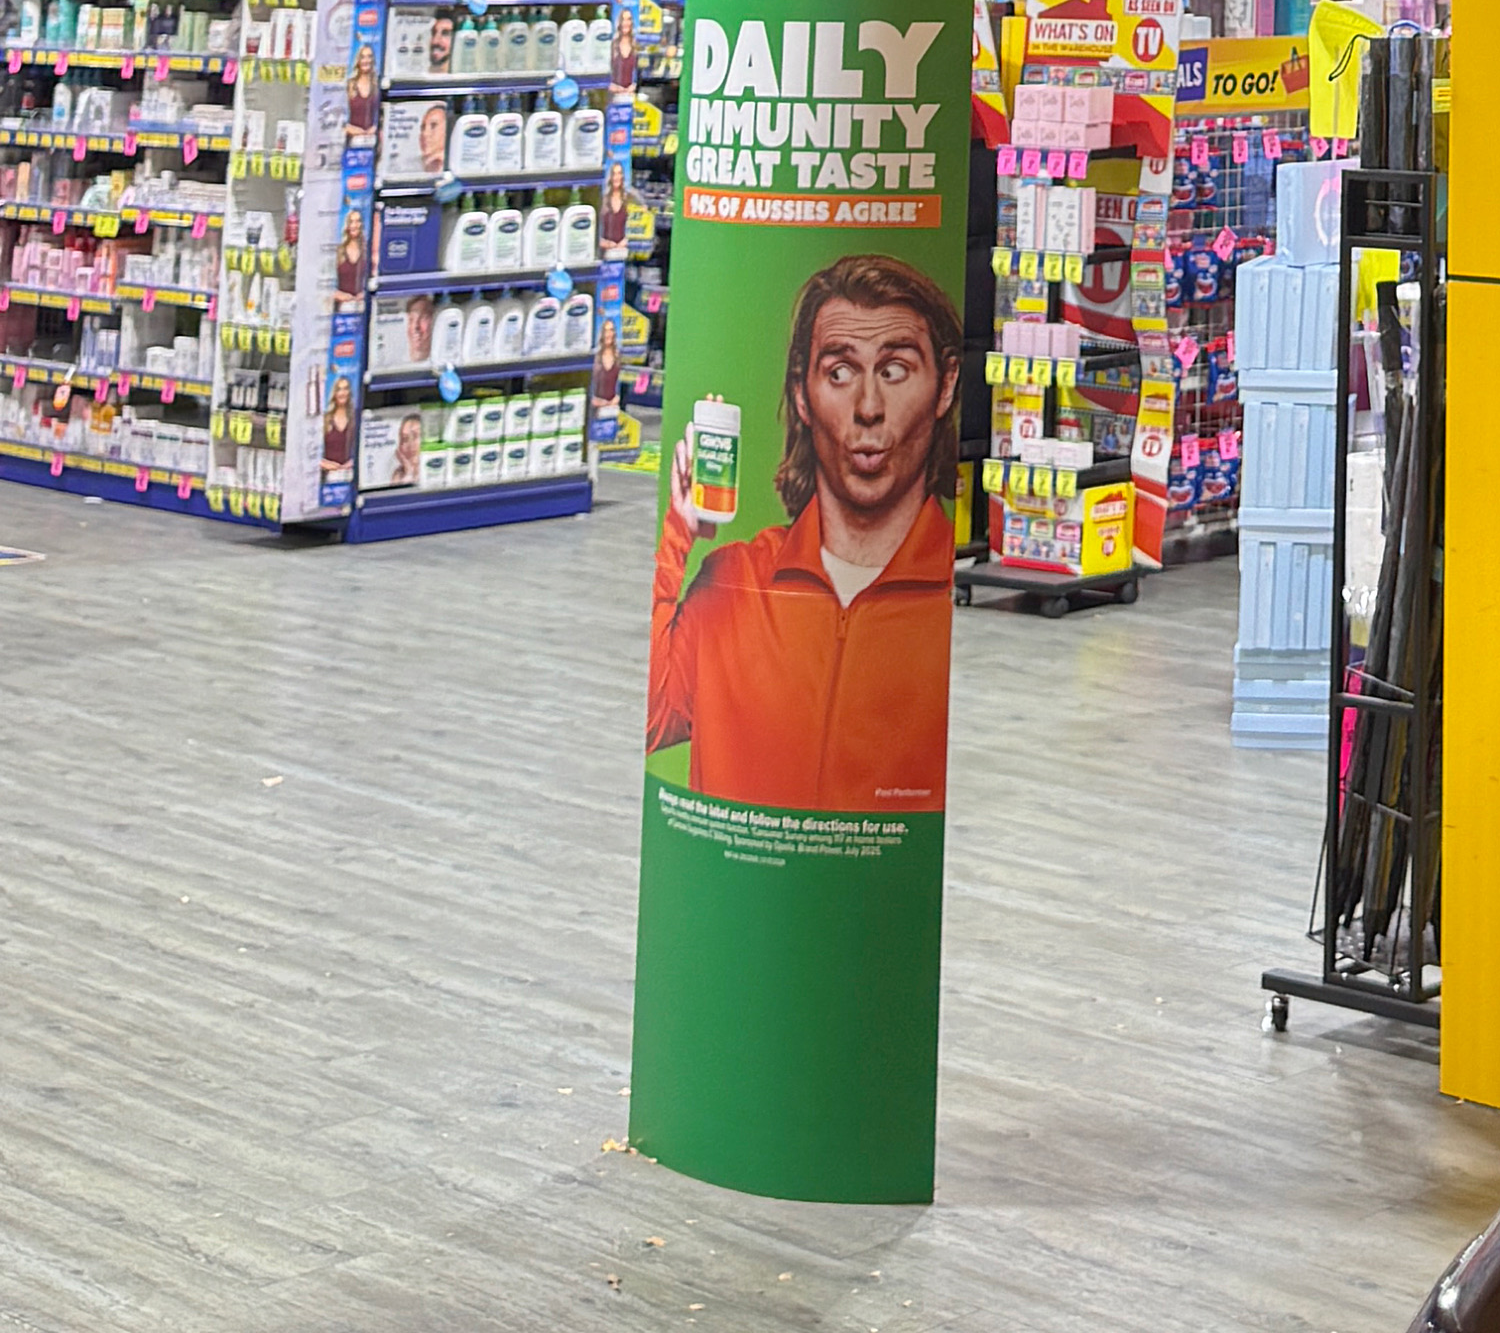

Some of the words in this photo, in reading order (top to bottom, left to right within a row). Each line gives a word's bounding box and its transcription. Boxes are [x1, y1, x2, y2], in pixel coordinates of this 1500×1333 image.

[1034, 22, 1089, 41] WHAT'S
[1094, 24, 1114, 42] ON
[1136, 26, 1161, 56] TV
[691, 19, 945, 99] DAILY
[1176, 61, 1202, 89] ALS
[1213, 73, 1237, 95] TO
[1241, 70, 1280, 95] GO!
[688, 99, 941, 149] IMMUNITY
[686, 145, 781, 188] GREAT
[790, 150, 936, 189] TASTE
[717, 196, 740, 218] OF
[742, 198, 830, 222] AUSSIES
[749, 810, 781, 828] follow
[782, 816, 800, 830] the
[802, 817, 860, 833] directions
[862, 819, 880, 833] for
[882, 820, 909, 834] use.
